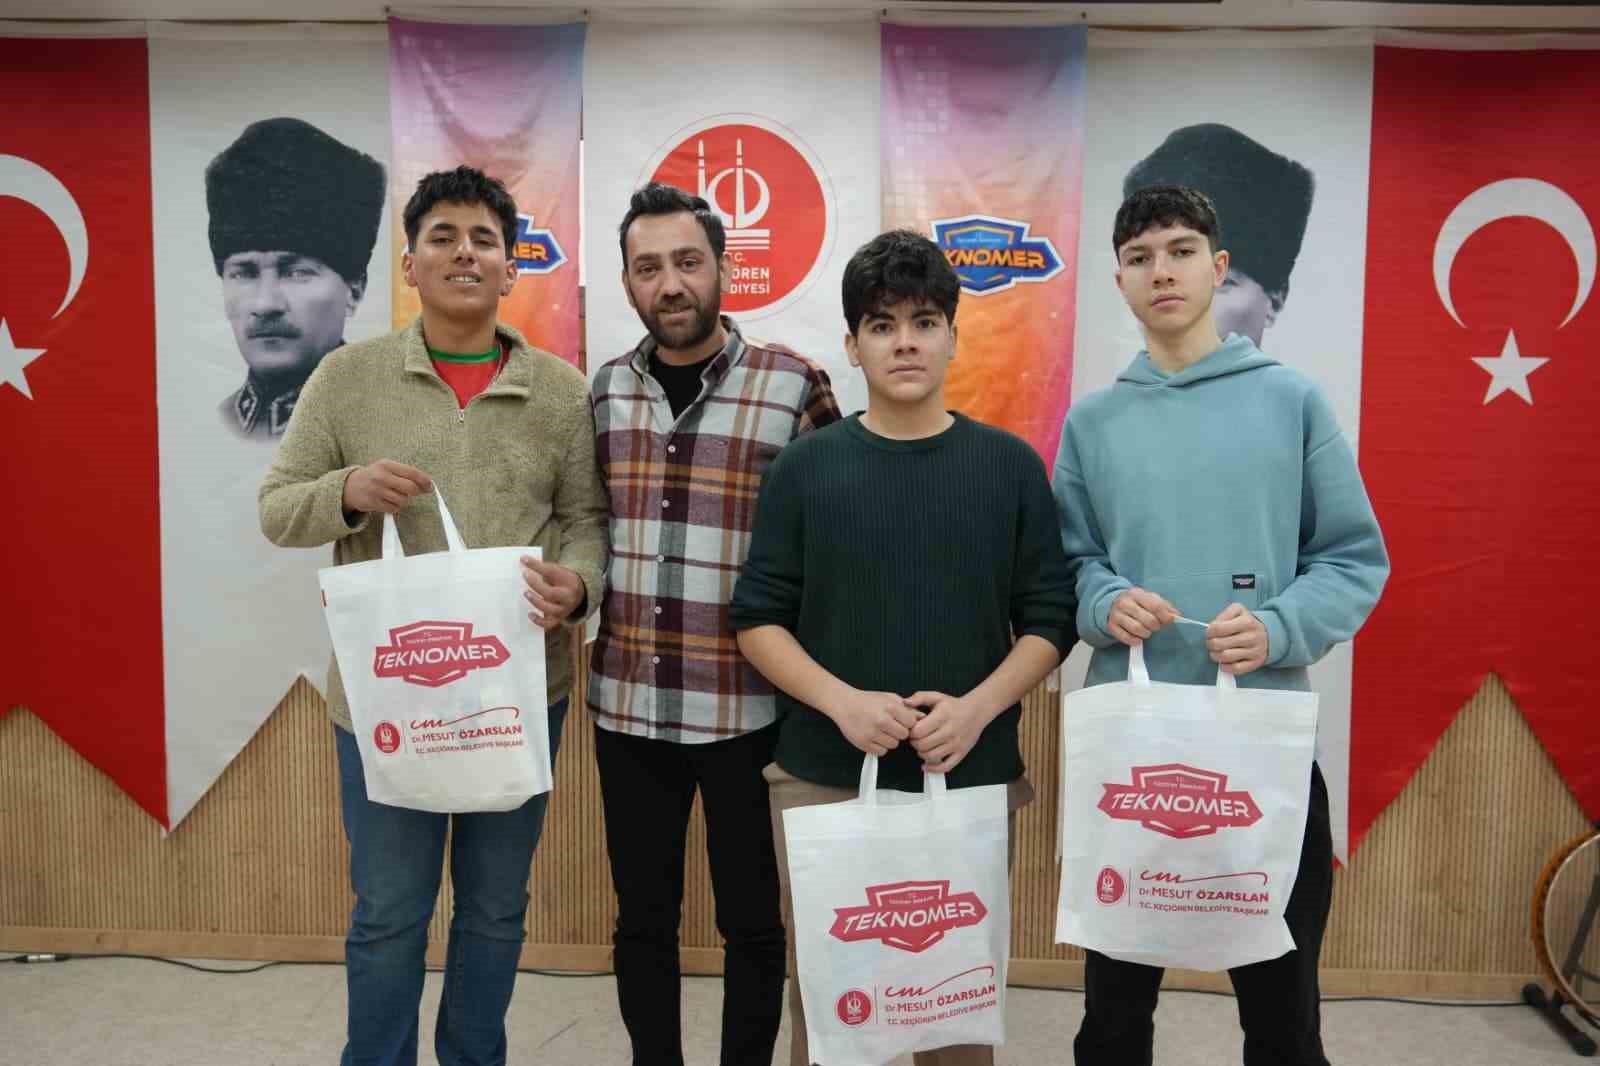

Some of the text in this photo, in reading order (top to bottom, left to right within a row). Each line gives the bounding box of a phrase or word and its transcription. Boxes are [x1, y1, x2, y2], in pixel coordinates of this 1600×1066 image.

[944, 248, 1046, 269] KNOMER
[731, 265, 770, 280] ÖREN
[730, 280, 770, 294] DİYESİ
[377, 644, 499, 669] TEKNOMER
[459, 724, 522, 740] ÖZARSLAN
[1111, 792, 1250, 818] TEKNOMER
[1152, 887, 1192, 900] MESUT
[1196, 888, 1269, 902] ÖZARSLAN
[844, 902, 976, 934] TEKNOMER
[897, 999, 933, 1012] MESUT
[937, 984, 995, 1006] ÖZARSLAN
